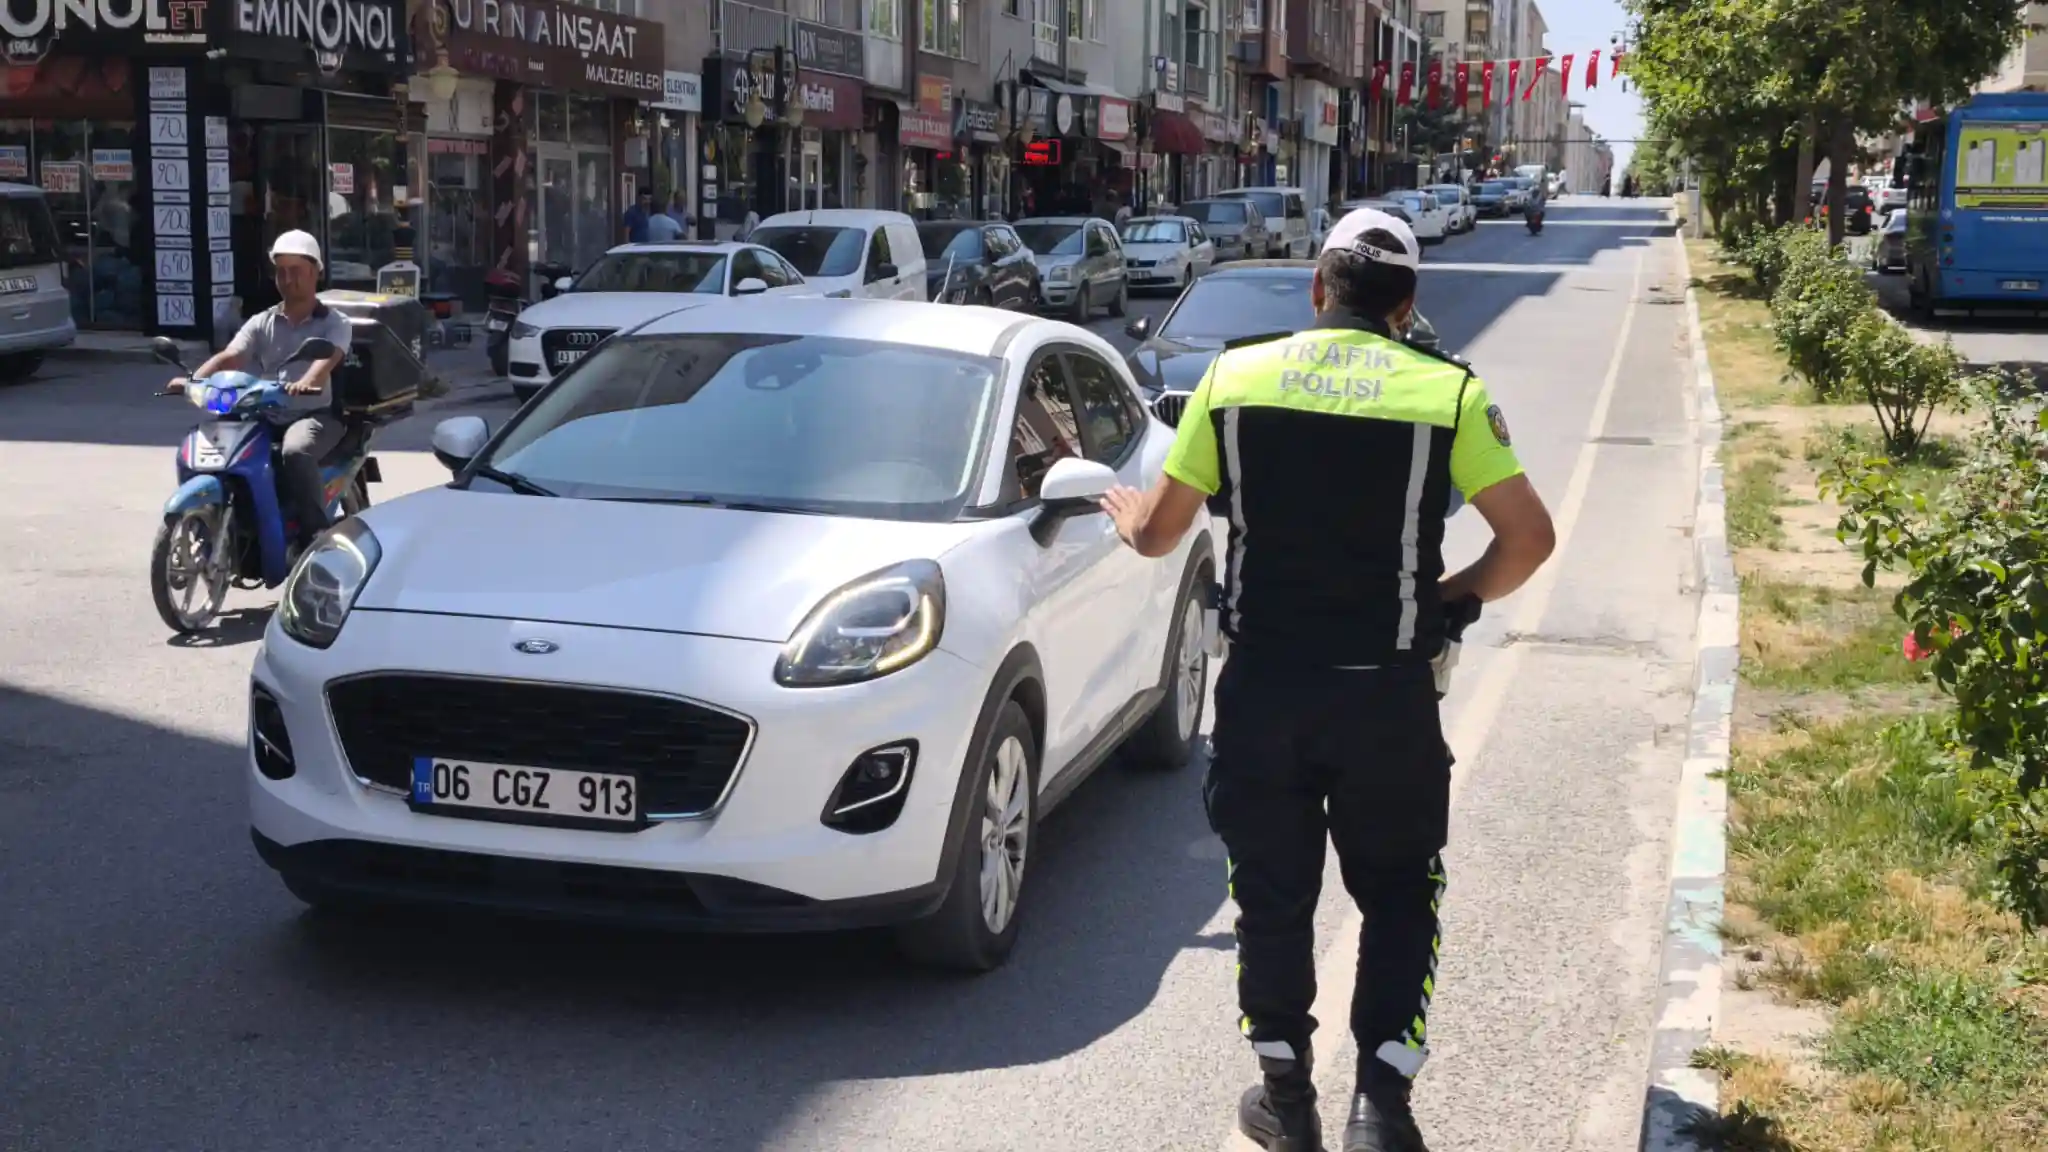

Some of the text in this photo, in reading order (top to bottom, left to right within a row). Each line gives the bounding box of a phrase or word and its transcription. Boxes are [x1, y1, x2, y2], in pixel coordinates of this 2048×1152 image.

[168, 1, 207, 30] ET
[555, 4, 638, 59] İNŞAAT
[417, 782, 431, 794] TR
[433, 763, 633, 816] 06 CGZ 913
